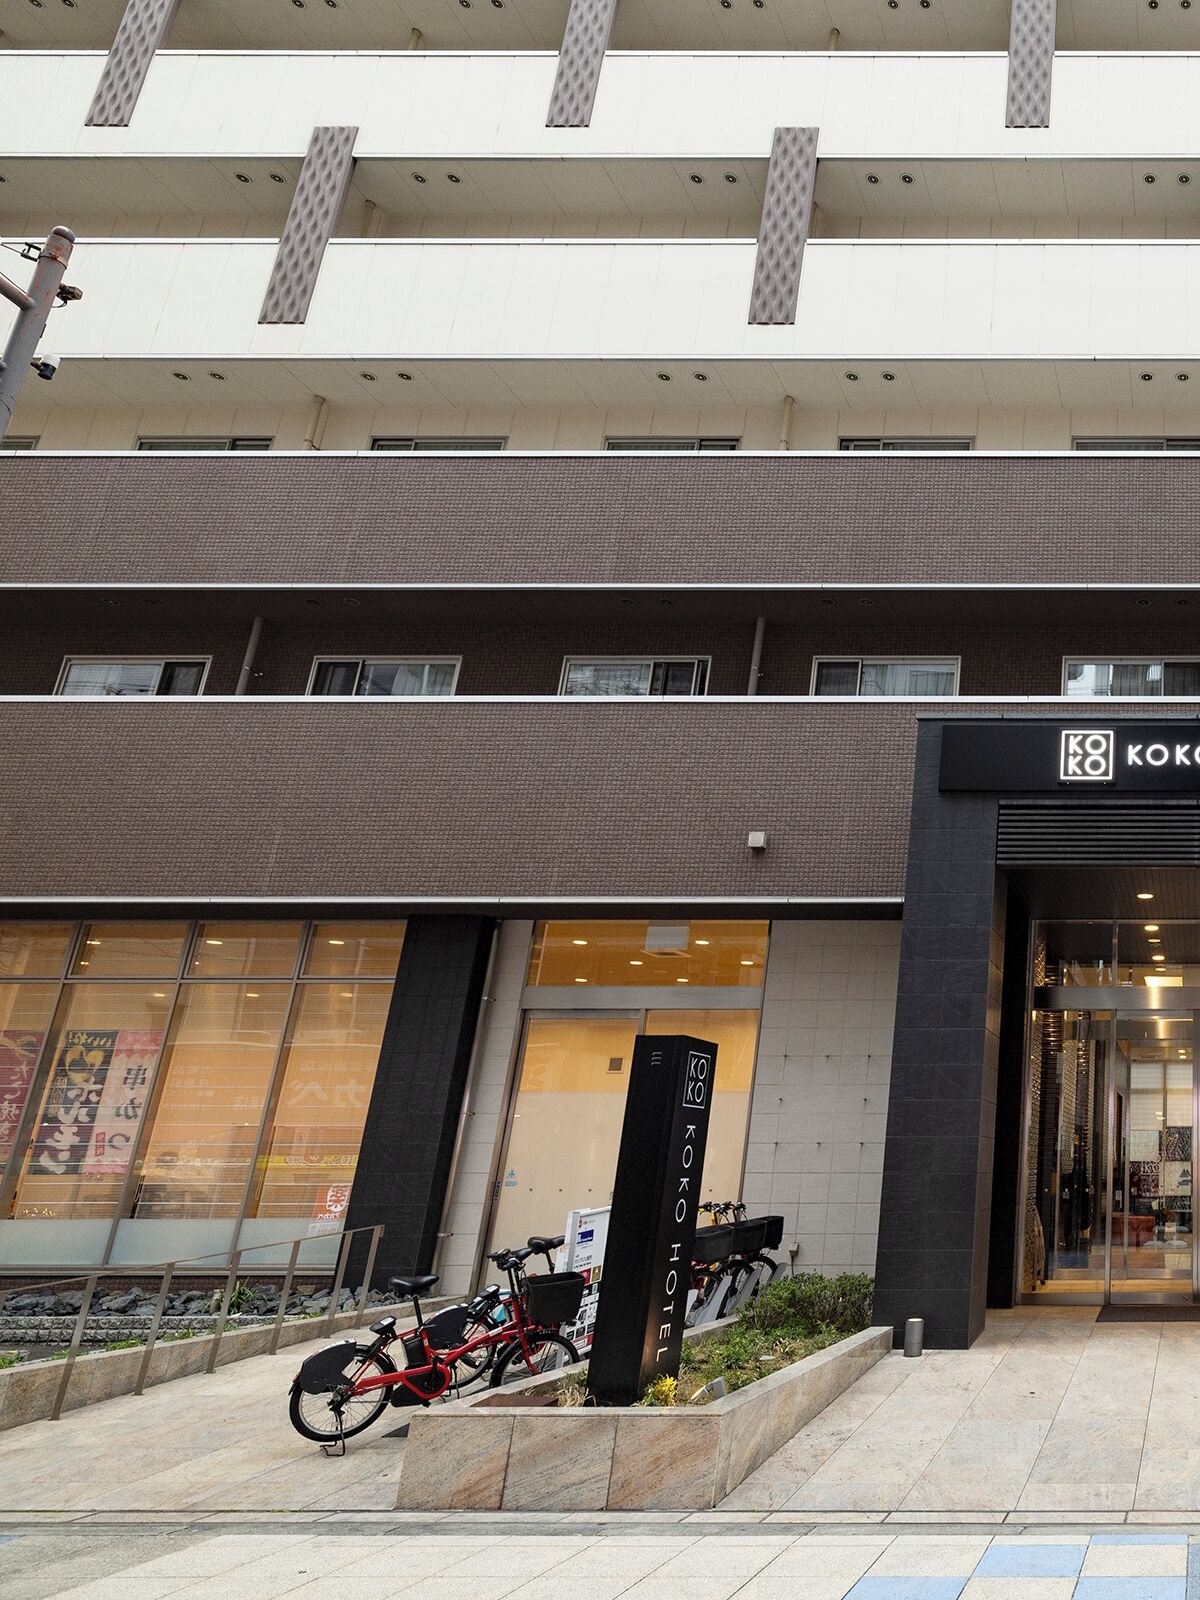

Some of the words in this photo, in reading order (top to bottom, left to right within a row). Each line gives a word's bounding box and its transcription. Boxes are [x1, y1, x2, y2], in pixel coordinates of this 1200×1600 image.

[1069, 735, 1107, 755] KO
[1068, 755, 1107, 775] KO
[690, 1057, 708, 1080] KO
[687, 1080, 705, 1103] KO
[675, 1125, 696, 1223] KOKO
[656, 1243, 682, 1363] HOTEL
